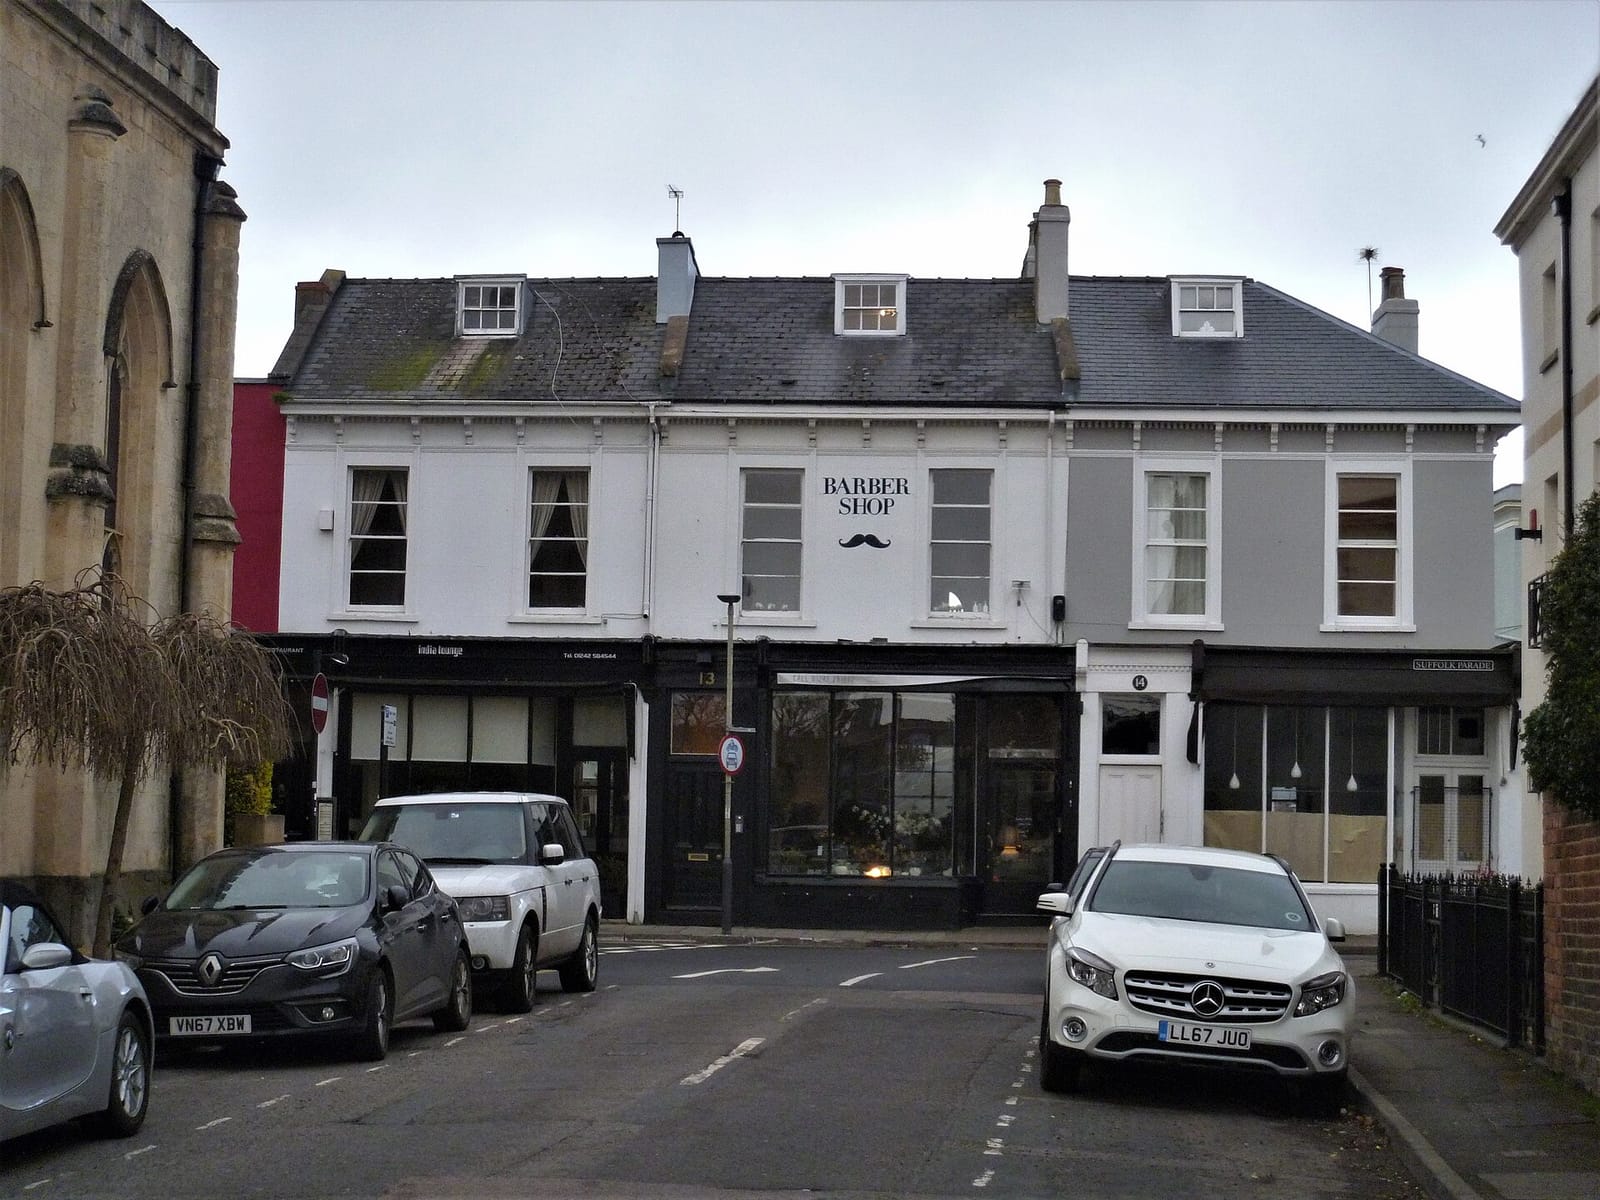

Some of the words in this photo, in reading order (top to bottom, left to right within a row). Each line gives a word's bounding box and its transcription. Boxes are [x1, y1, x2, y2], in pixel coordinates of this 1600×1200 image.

[823, 477, 910, 495] BARBER
[838, 497, 895, 515] SHOP
[1415, 660, 1456, 669] SUFFOLK
[1457, 661, 1491, 670] PARADE
[699, 671, 716, 686] 13
[1135, 677, 1145, 687] 14
[176, 1018, 213, 1033] VN67
[217, 1016, 245, 1032] XBW
[1170, 1024, 1213, 1043] LL67
